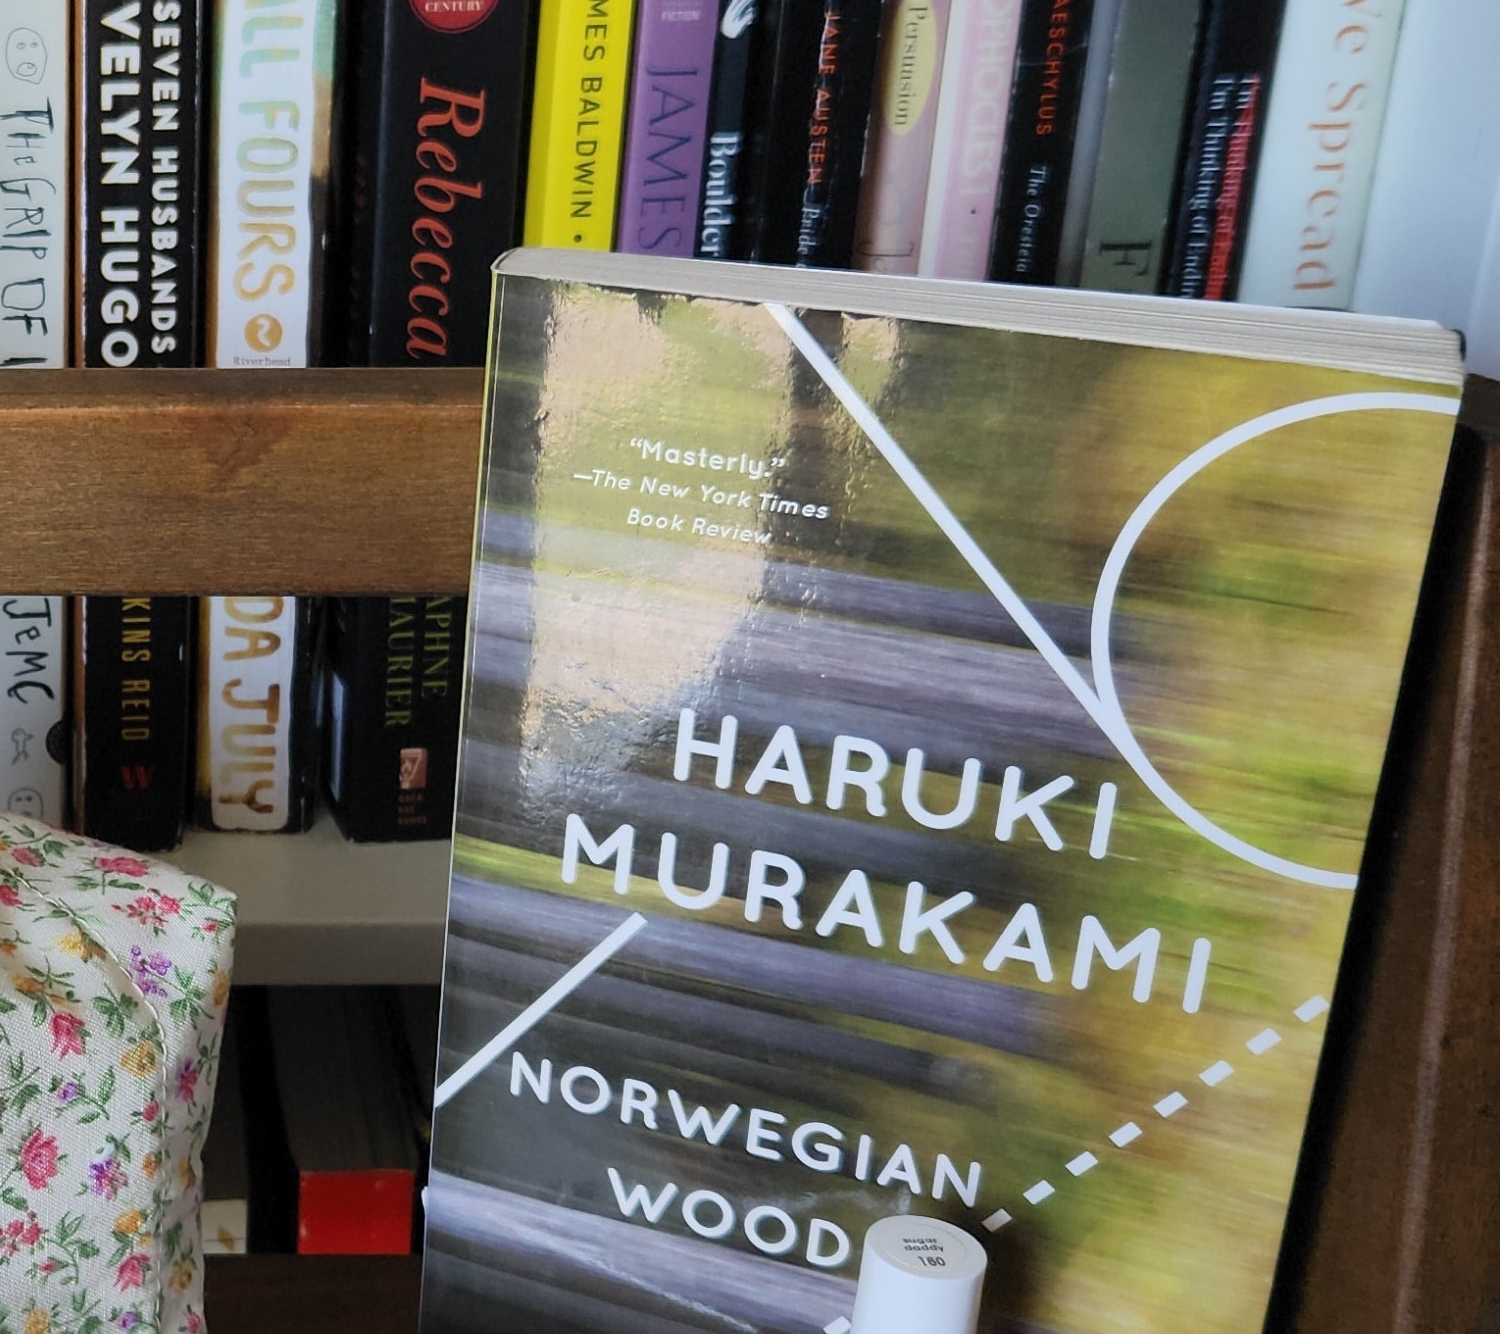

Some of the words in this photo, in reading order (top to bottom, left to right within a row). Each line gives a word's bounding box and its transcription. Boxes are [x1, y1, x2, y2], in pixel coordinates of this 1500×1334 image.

[424, 0, 485, 13] CENTURY
[817, 10, 841, 75] JANE
[893, 5, 929, 127] Persuasion
[569, 75, 604, 219] BALDWIN
[638, 61, 698, 252] JAMES
[806, 88, 831, 185] AUSTEN
[1023, 165, 1047, 199] The
[1294, 80, 1368, 291] Spread
[232, 99, 300, 302] FOURS
[406, 76, 487, 360] Rebecca
[701, 131, 743, 258] Boulder
[1015, 204, 1040, 274] Oresteia
[0, 276, 49, 338] OF
[100, 207, 140, 367] HUGO
[151, 149, 180, 356] HUSBANDS
[233, 356, 291, 367] Riverhead
[626, 507, 684, 532] Book
[691, 517, 773, 545] Review
[640, 478, 690, 499] New
[700, 484, 752, 508] York
[758, 492, 831, 519] Times
[121, 679, 151, 742] REID
[218, 677, 281, 815] JULY
[672, 705, 1119, 862] HARUKI
[559, 811, 1212, 1016] MURAKAMI
[508, 1049, 985, 1209] NORWEGIAN
[606, 1166, 853, 1269] WOOD
[902, 1237, 937, 1245] sugar
[904, 1244, 944, 1253] daddy
